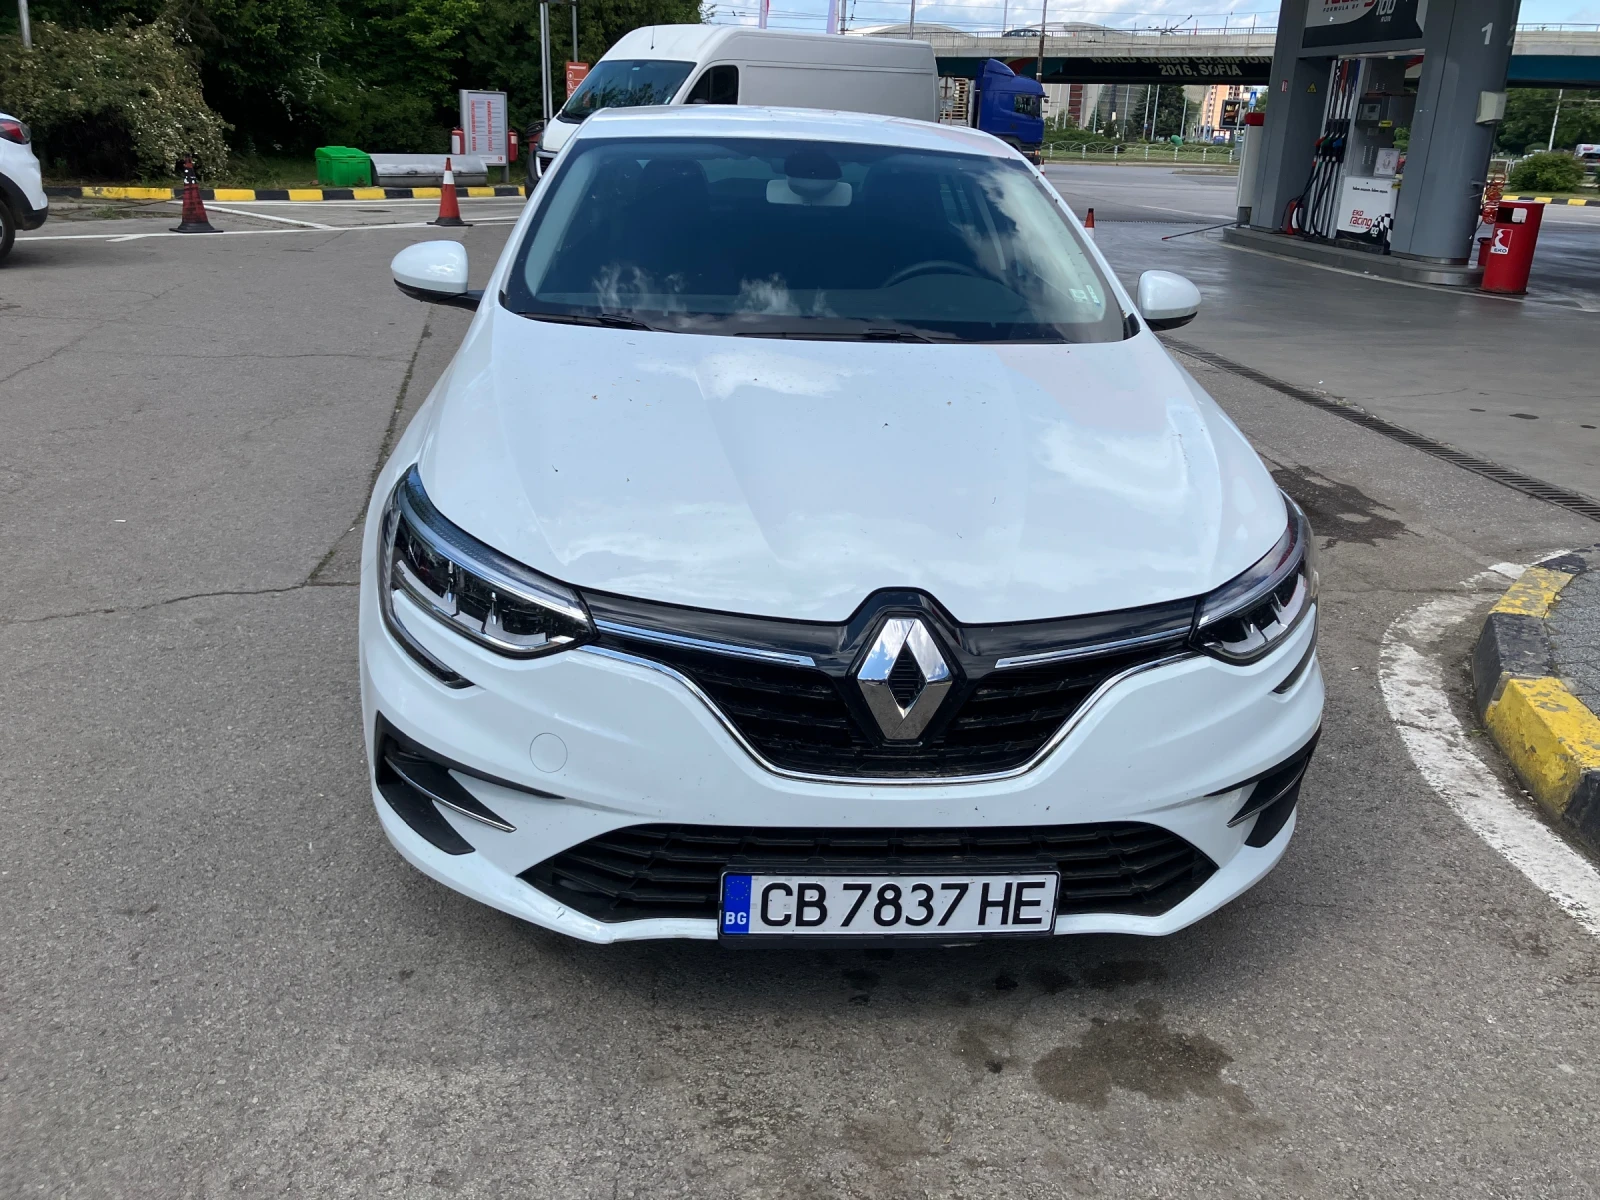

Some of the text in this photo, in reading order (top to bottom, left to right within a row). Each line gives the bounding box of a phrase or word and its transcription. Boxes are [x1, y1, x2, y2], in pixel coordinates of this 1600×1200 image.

[1322, 5, 1349, 13] FORMULA
[1375, 0, 1396, 15] 100
[1481, 22, 1493, 45] 1
[1192, 56, 1273, 64] CHAMPION
[1158, 64, 1243, 77] 2016, SOFIA
[1350, 216, 1373, 229] racing
[760, 881, 1047, 928] CB 7837 HE
[725, 911, 748, 926] BG
